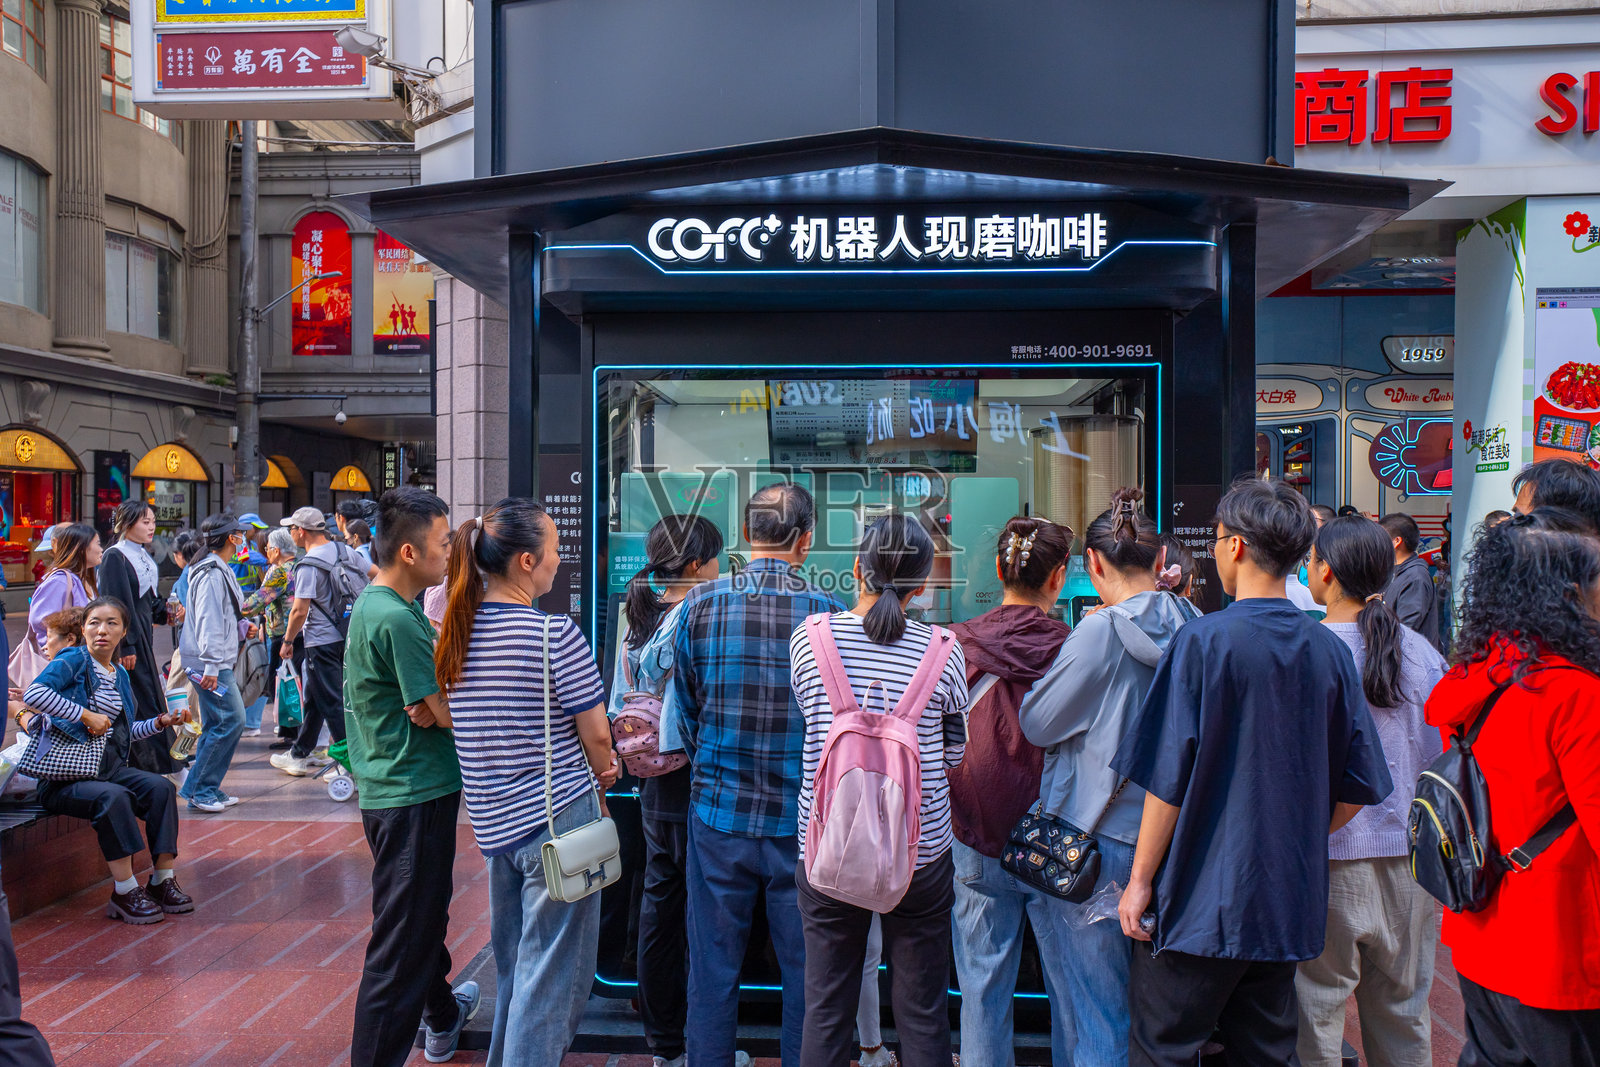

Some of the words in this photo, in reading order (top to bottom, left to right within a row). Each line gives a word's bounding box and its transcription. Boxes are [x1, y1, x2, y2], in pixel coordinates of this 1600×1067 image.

[231, 46, 321, 76] 萬有全
[1295, 67, 1453, 146] 商店
[790, 213, 1108, 260] 机器人现磨咖啡
[1011, 345, 1042, 354] 客服电话
[1401, 347, 1446, 362] 1959
[1256, 389, 1297, 404] 大白兔
[1384, 387, 1420, 403] White
[1173, 527, 1214, 536] 冠军的手艺
[614, 555, 650, 563] 倡导环保无
